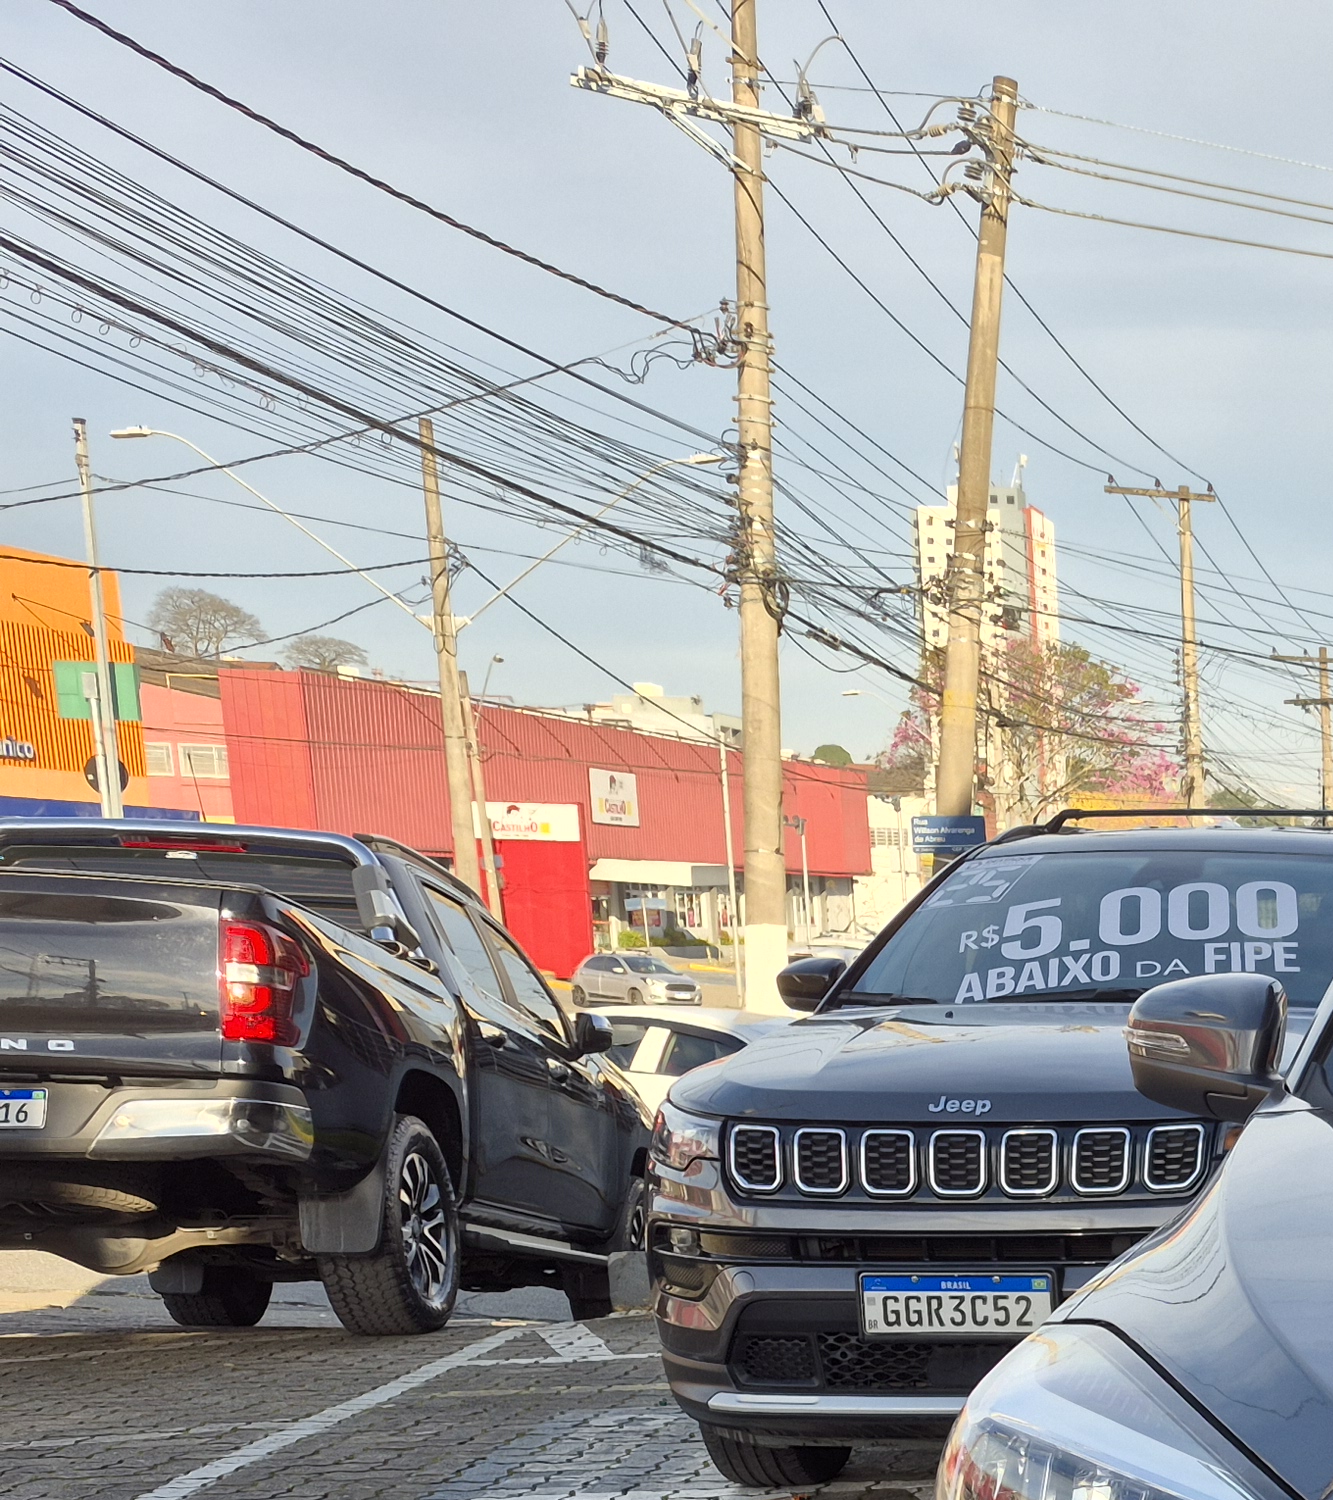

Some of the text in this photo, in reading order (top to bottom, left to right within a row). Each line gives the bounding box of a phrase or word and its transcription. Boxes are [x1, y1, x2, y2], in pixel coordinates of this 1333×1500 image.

[954, 942, 1301, 1004] ABAIXO DA FIPE
[928, 1096, 992, 1115] Jeep
[941, 1281, 971, 1290] BRASIL
[881, 1295, 1033, 1328] GGR3C52
[868, 1319, 879, 1330] BR
